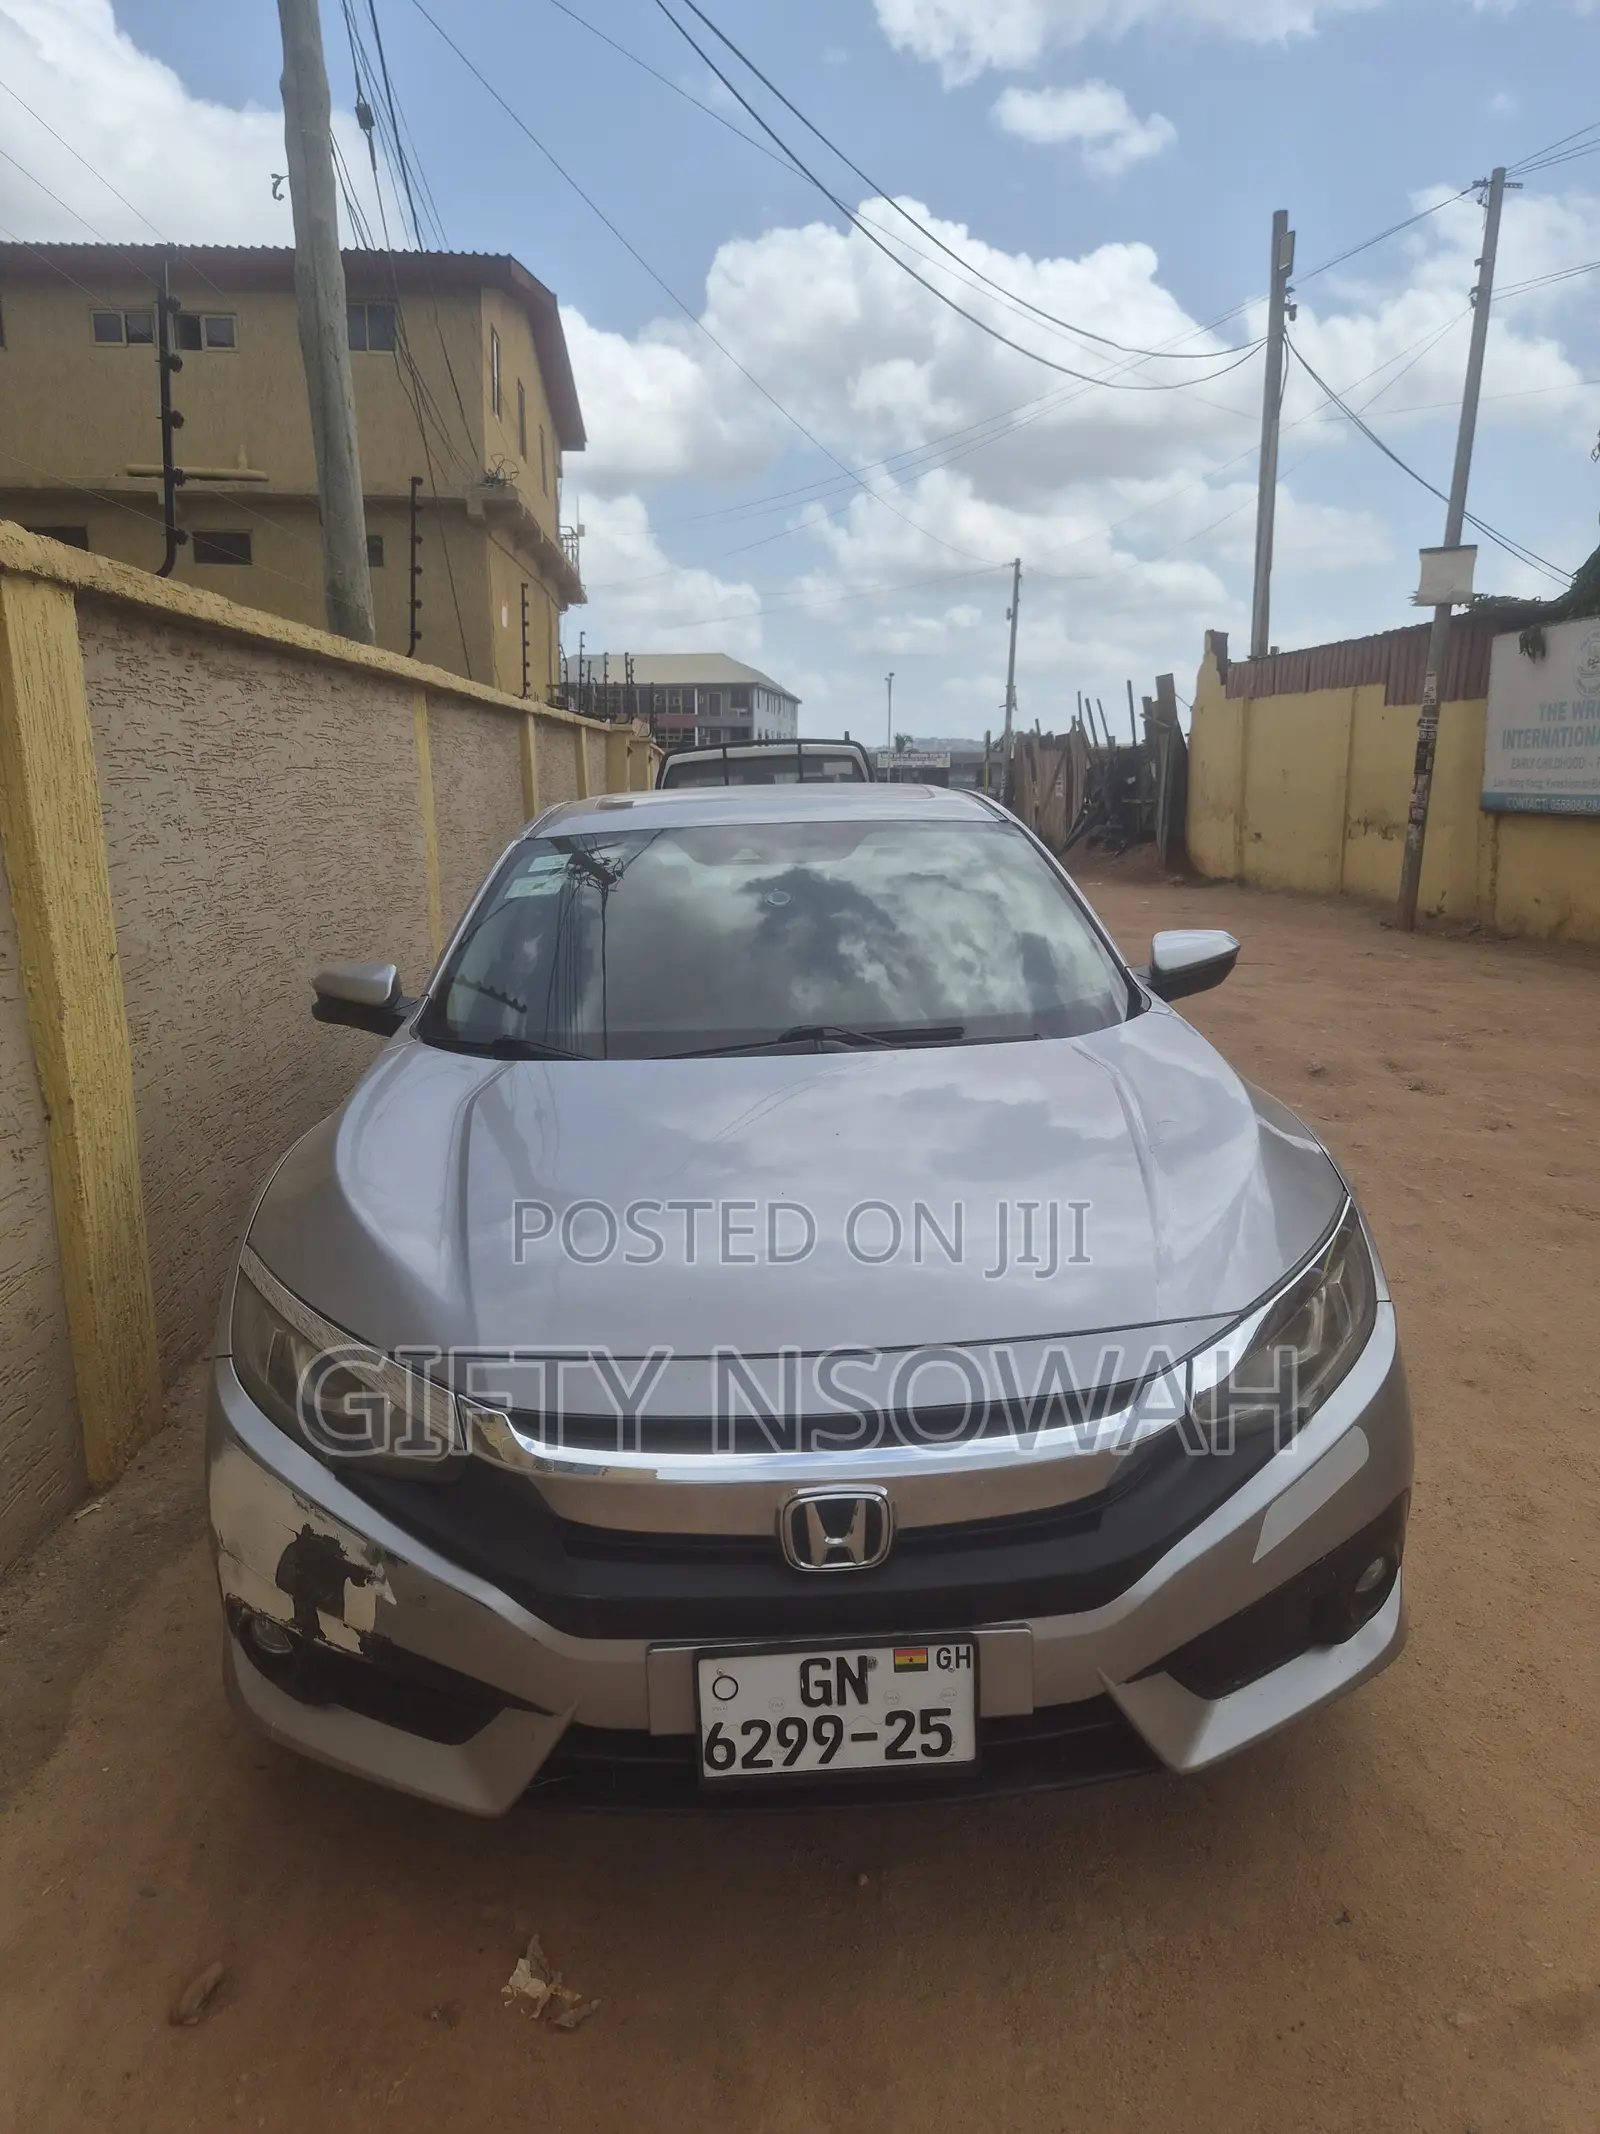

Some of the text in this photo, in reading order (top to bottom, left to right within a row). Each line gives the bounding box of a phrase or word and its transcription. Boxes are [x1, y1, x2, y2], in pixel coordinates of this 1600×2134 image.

[1538, 702, 1568, 722] THE
[800, 1646, 971, 1708] GN GH
[704, 1708, 953, 1771] 6299-25
